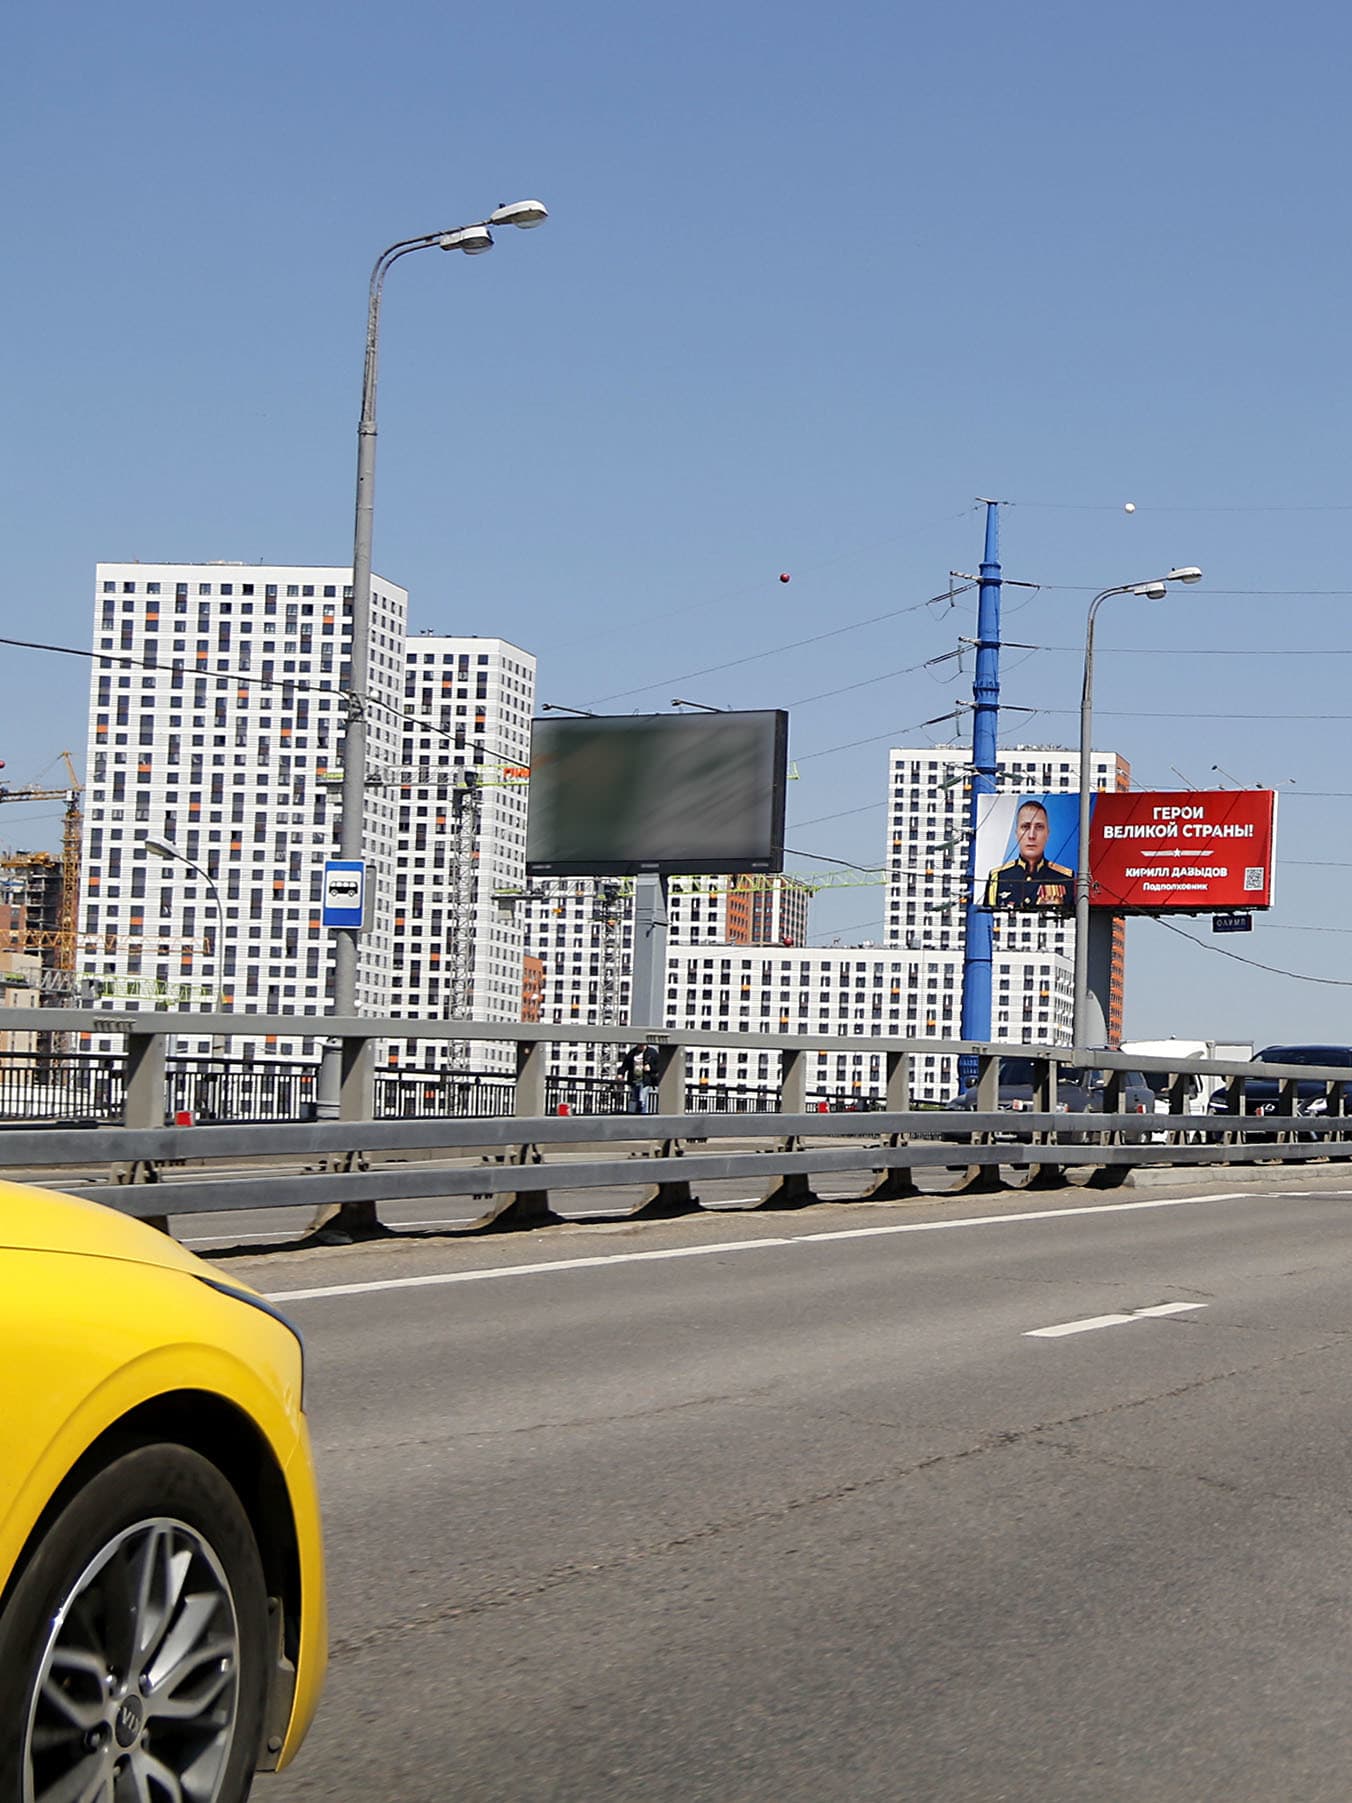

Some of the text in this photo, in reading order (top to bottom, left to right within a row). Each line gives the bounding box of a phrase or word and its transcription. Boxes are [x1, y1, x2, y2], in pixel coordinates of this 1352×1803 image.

[1153, 806, 1204, 820] ГЕРОИ
[1103, 822, 1254, 838] ВЕЛИКОЙ СТРАНЫ!
[1125, 866, 1228, 878] КИРИЛЛ ДАВЫДОВ
[1143, 882, 1209, 891] Подполковник
